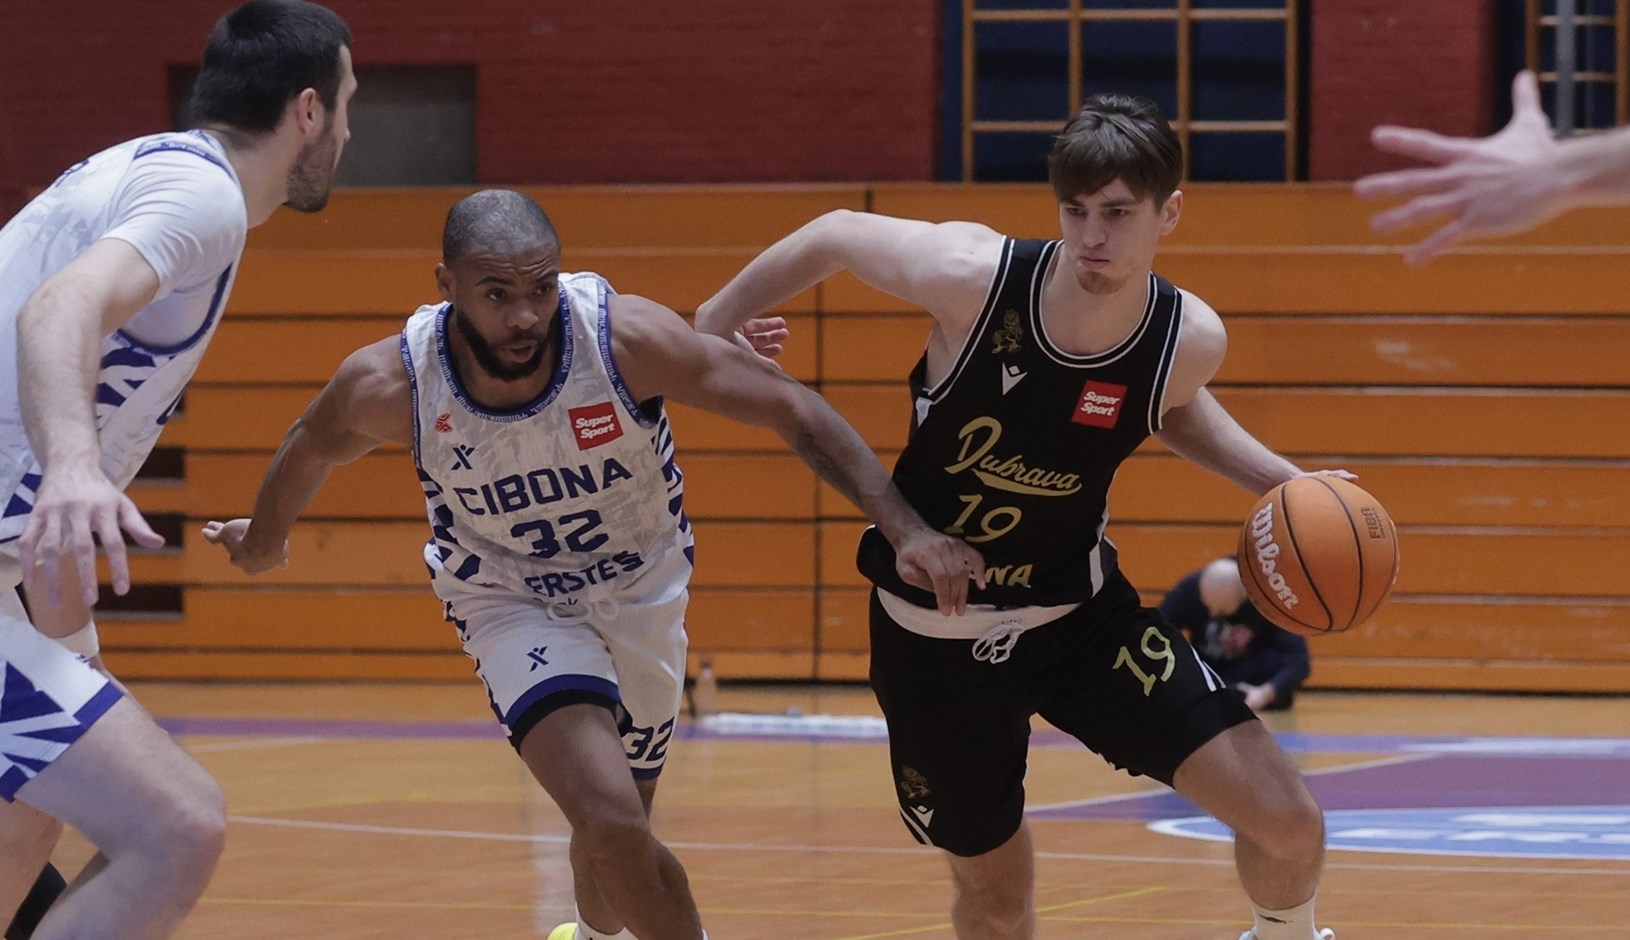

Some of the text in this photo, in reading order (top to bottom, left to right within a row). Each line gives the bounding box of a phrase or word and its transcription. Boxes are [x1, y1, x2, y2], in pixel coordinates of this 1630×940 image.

[575, 414, 614, 428] Super
[1081, 402, 1115, 416] Sport
[1083, 391, 1120, 404] Super
[580, 423, 615, 439] Sport
[944, 416, 1082, 496] Dubrava
[452, 457, 632, 515] CIBONA
[510, 509, 609, 559] 32
[944, 493, 1022, 543] 19
[1252, 502, 1299, 610] Wilson
[1112, 626, 1175, 697] 19
[624, 716, 675, 762] 32
